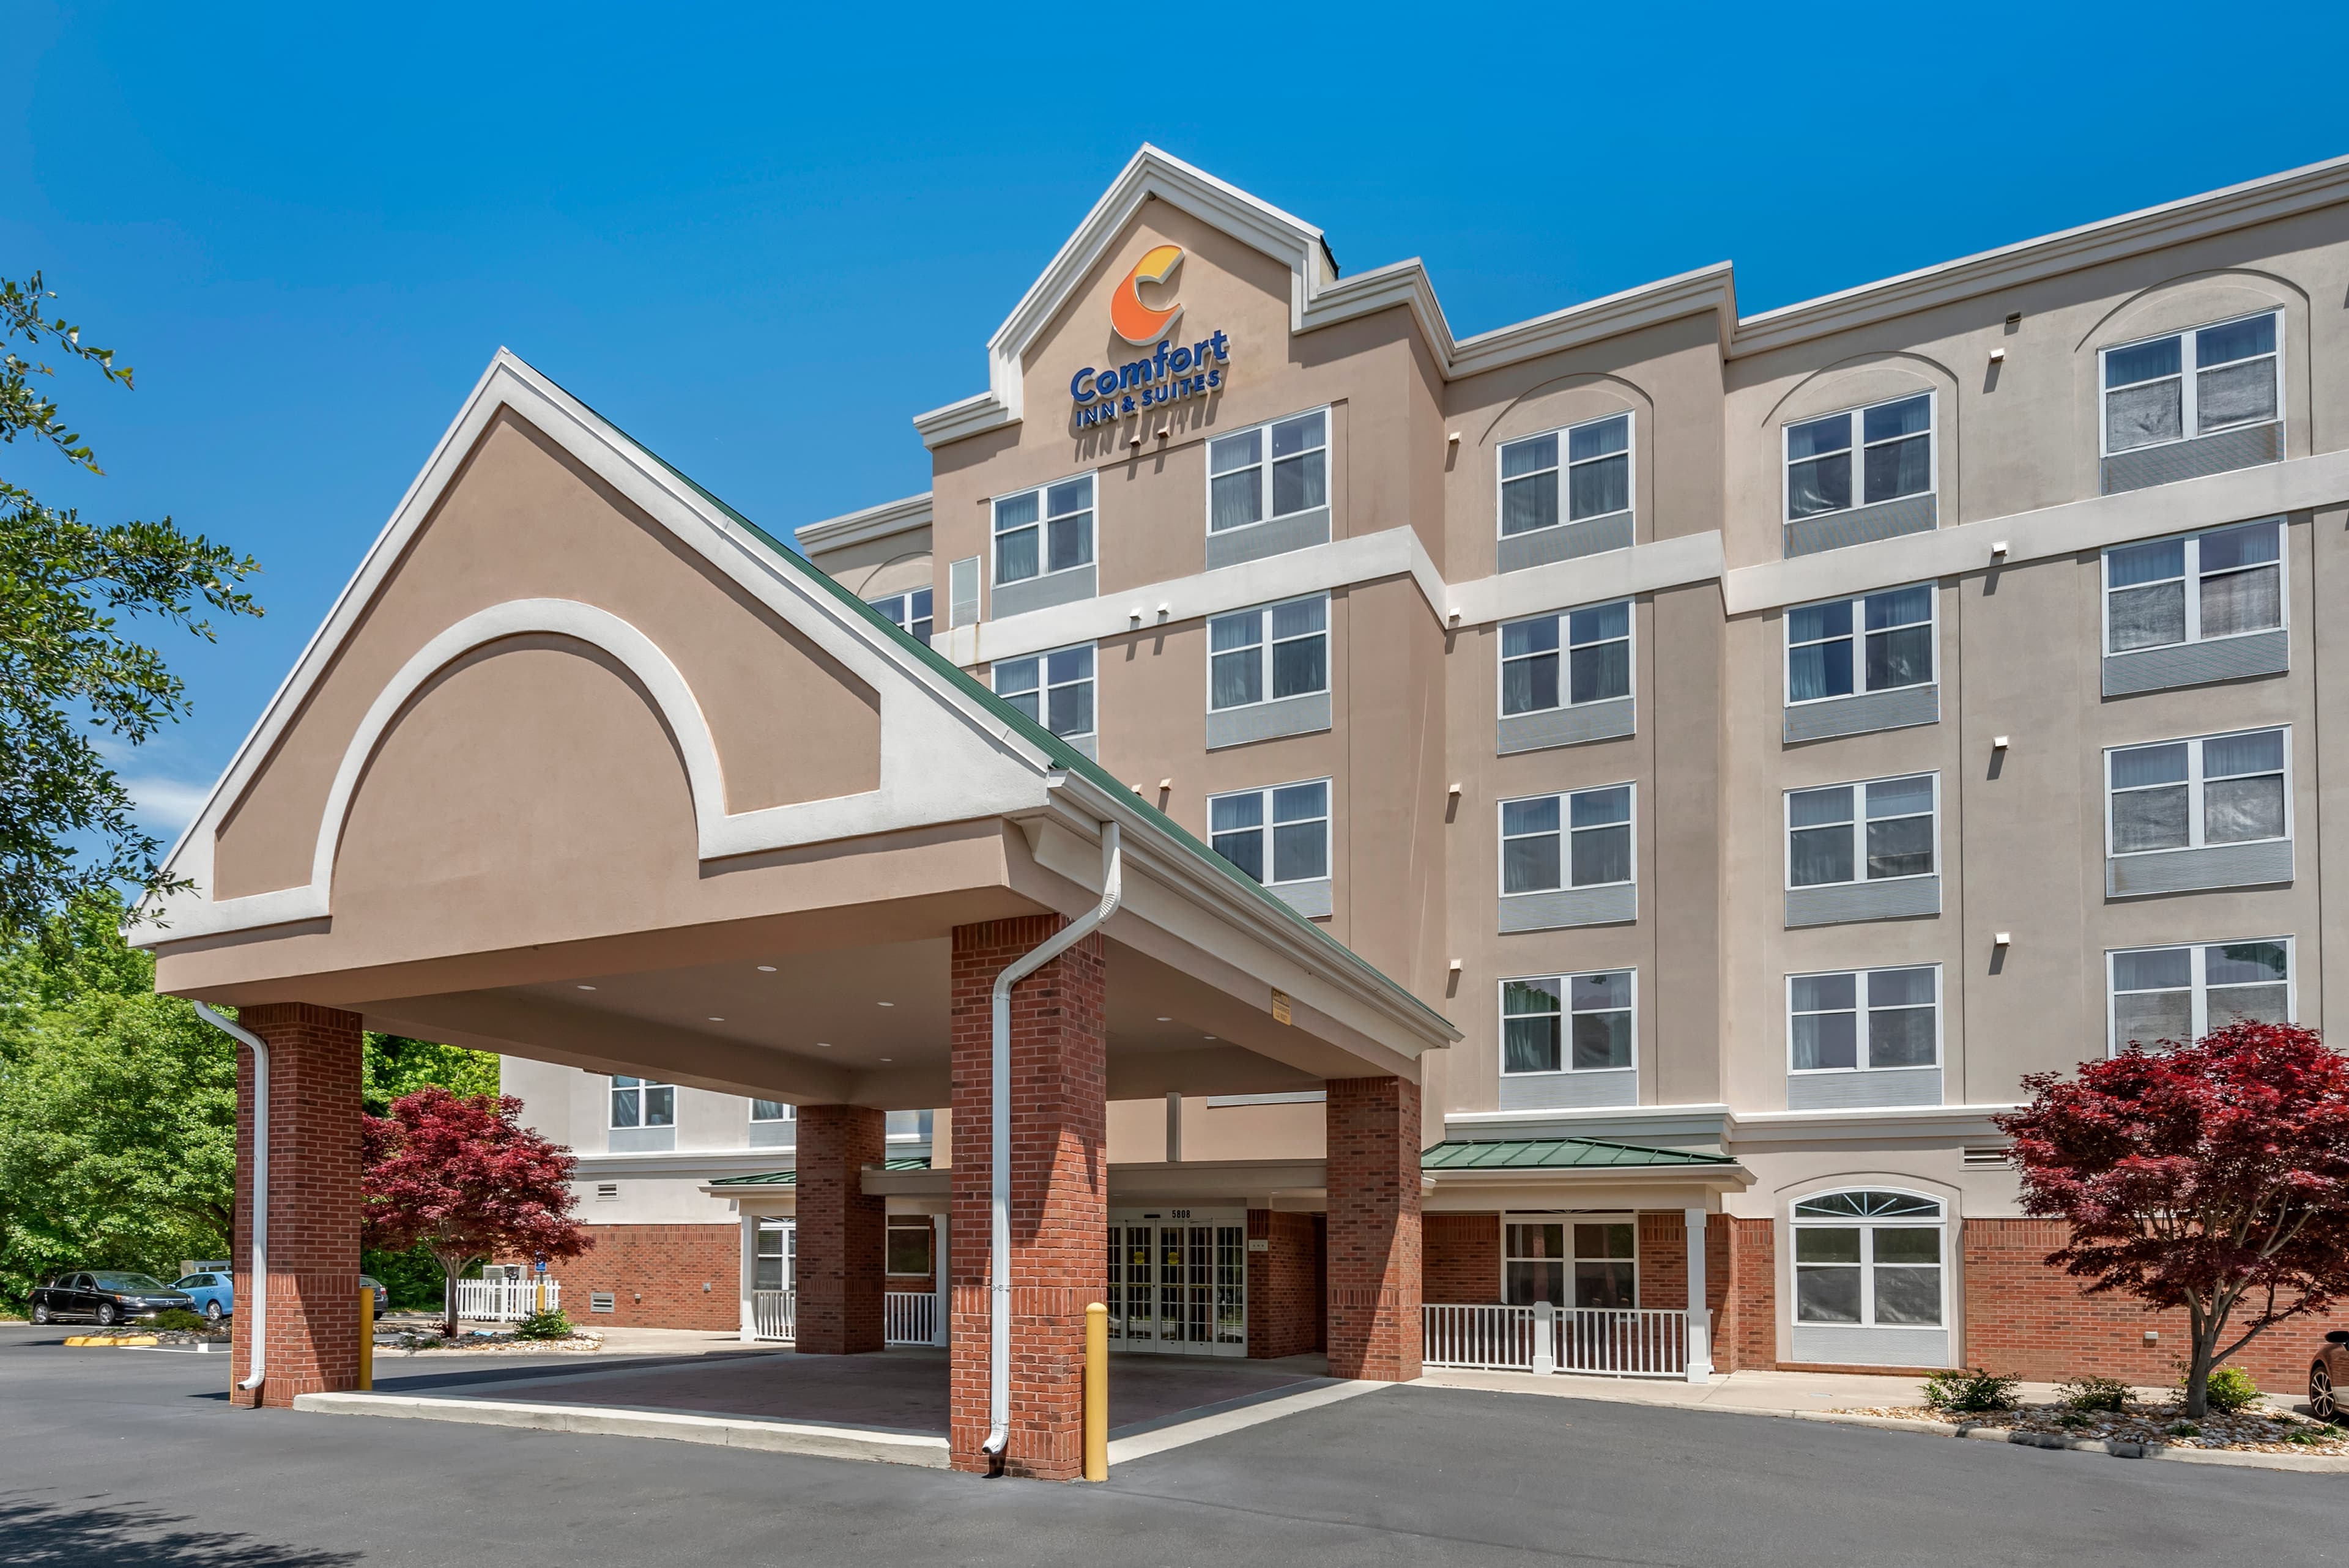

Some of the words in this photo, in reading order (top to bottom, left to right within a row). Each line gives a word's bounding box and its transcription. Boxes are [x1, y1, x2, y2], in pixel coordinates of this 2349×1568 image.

[1071, 330, 1229, 404] Comfort
[1077, 401, 1116, 428] INN
[1121, 396, 1136, 414] &
[1141, 369, 1221, 405] SUITES
[1172, 1210, 1190, 1219] 5808
